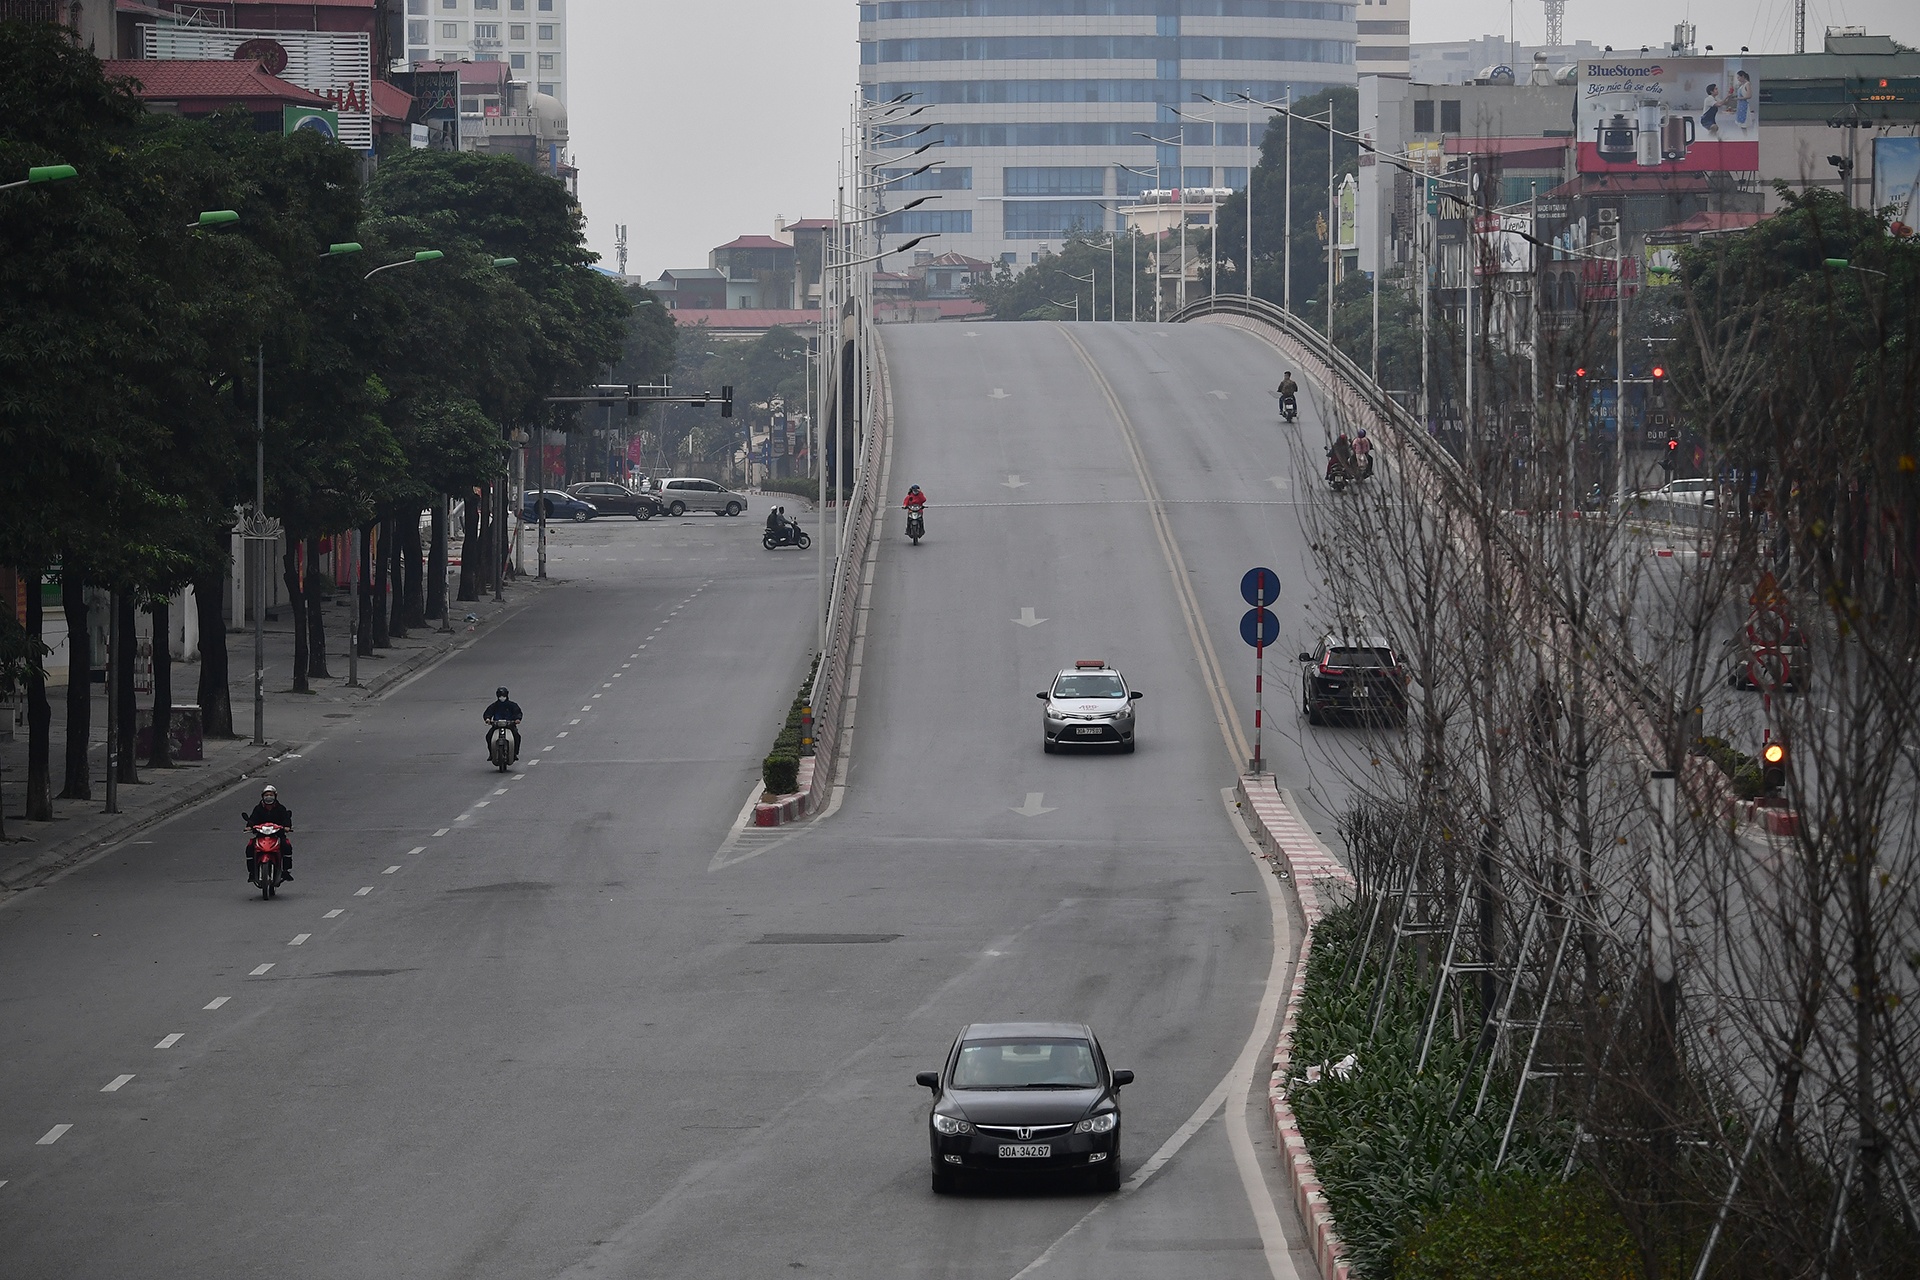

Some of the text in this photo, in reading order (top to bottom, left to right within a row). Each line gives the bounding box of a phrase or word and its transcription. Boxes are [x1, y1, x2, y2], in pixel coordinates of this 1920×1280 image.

[1588, 65, 1650, 77] BlueStone
[1587, 83, 1605, 96] Bếp
[1606, 82, 1621, 91] núc
[1646, 82, 1663, 94] chia
[1000, 1146, 1049, 1157] 30A-342.67
